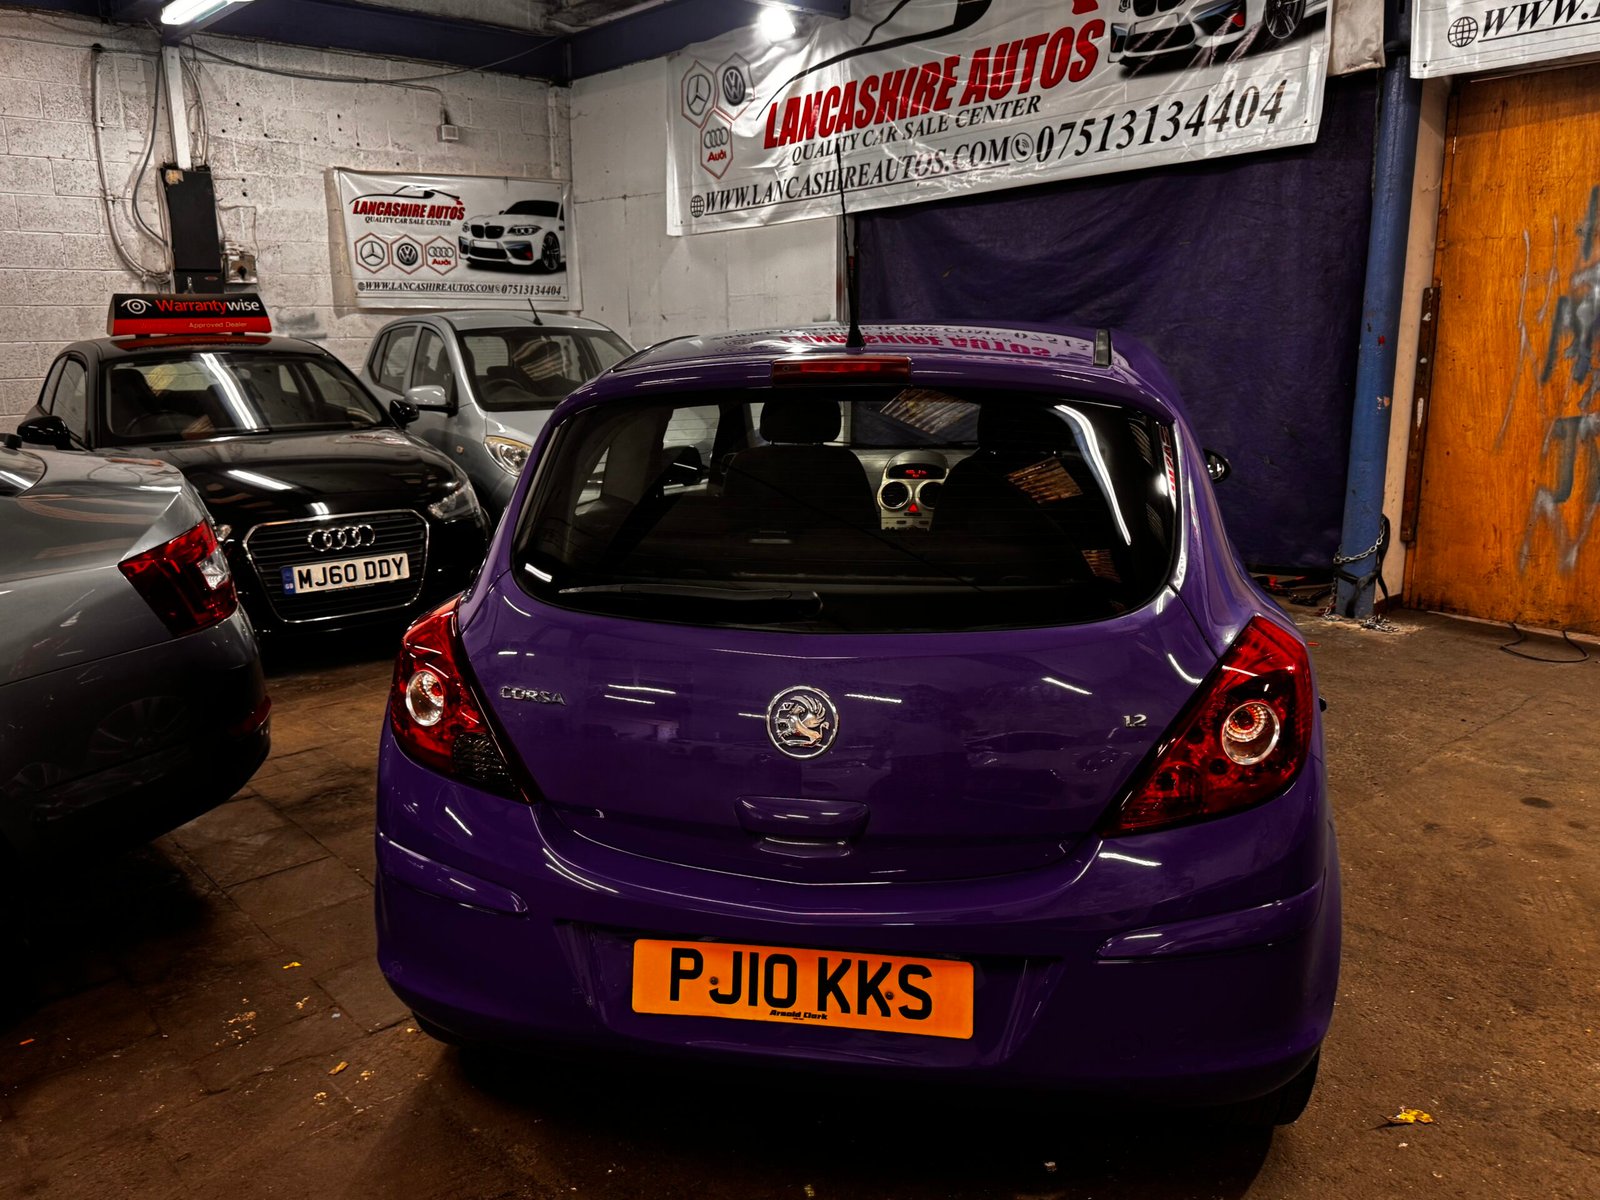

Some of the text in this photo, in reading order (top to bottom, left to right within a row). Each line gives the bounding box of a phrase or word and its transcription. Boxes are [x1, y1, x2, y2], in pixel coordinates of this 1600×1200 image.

[1482, 0, 1600, 38] WWW.
[763, 18, 1106, 150] LANCASHIRE AUTOS
[1036, 79, 1288, 163] 07513134404
[792, 95, 1042, 166] QUALITY CAR SALE CENTER
[707, 149, 727, 164] Audi
[353, 200, 466, 221] LANCASHIRE AUTOS
[365, 216, 452, 227] QUALITY CAR SALE CENTER
[432, 258, 452, 266] Audi
[365, 281, 495, 293] WWW.LANCASHIREAUTOS.COM
[501, 284, 561, 296] 07513134404
[155, 299, 260, 314] Warrantywise
[189, 321, 224, 329] Approved
[297, 556, 403, 589] MJ60 DDY
[500, 685, 567, 706] CORSA
[669, 947, 933, 1021] PJ10 KKS
[769, 1009, 802, 1018] Arnold
[803, 1011, 828, 1020] Clark
